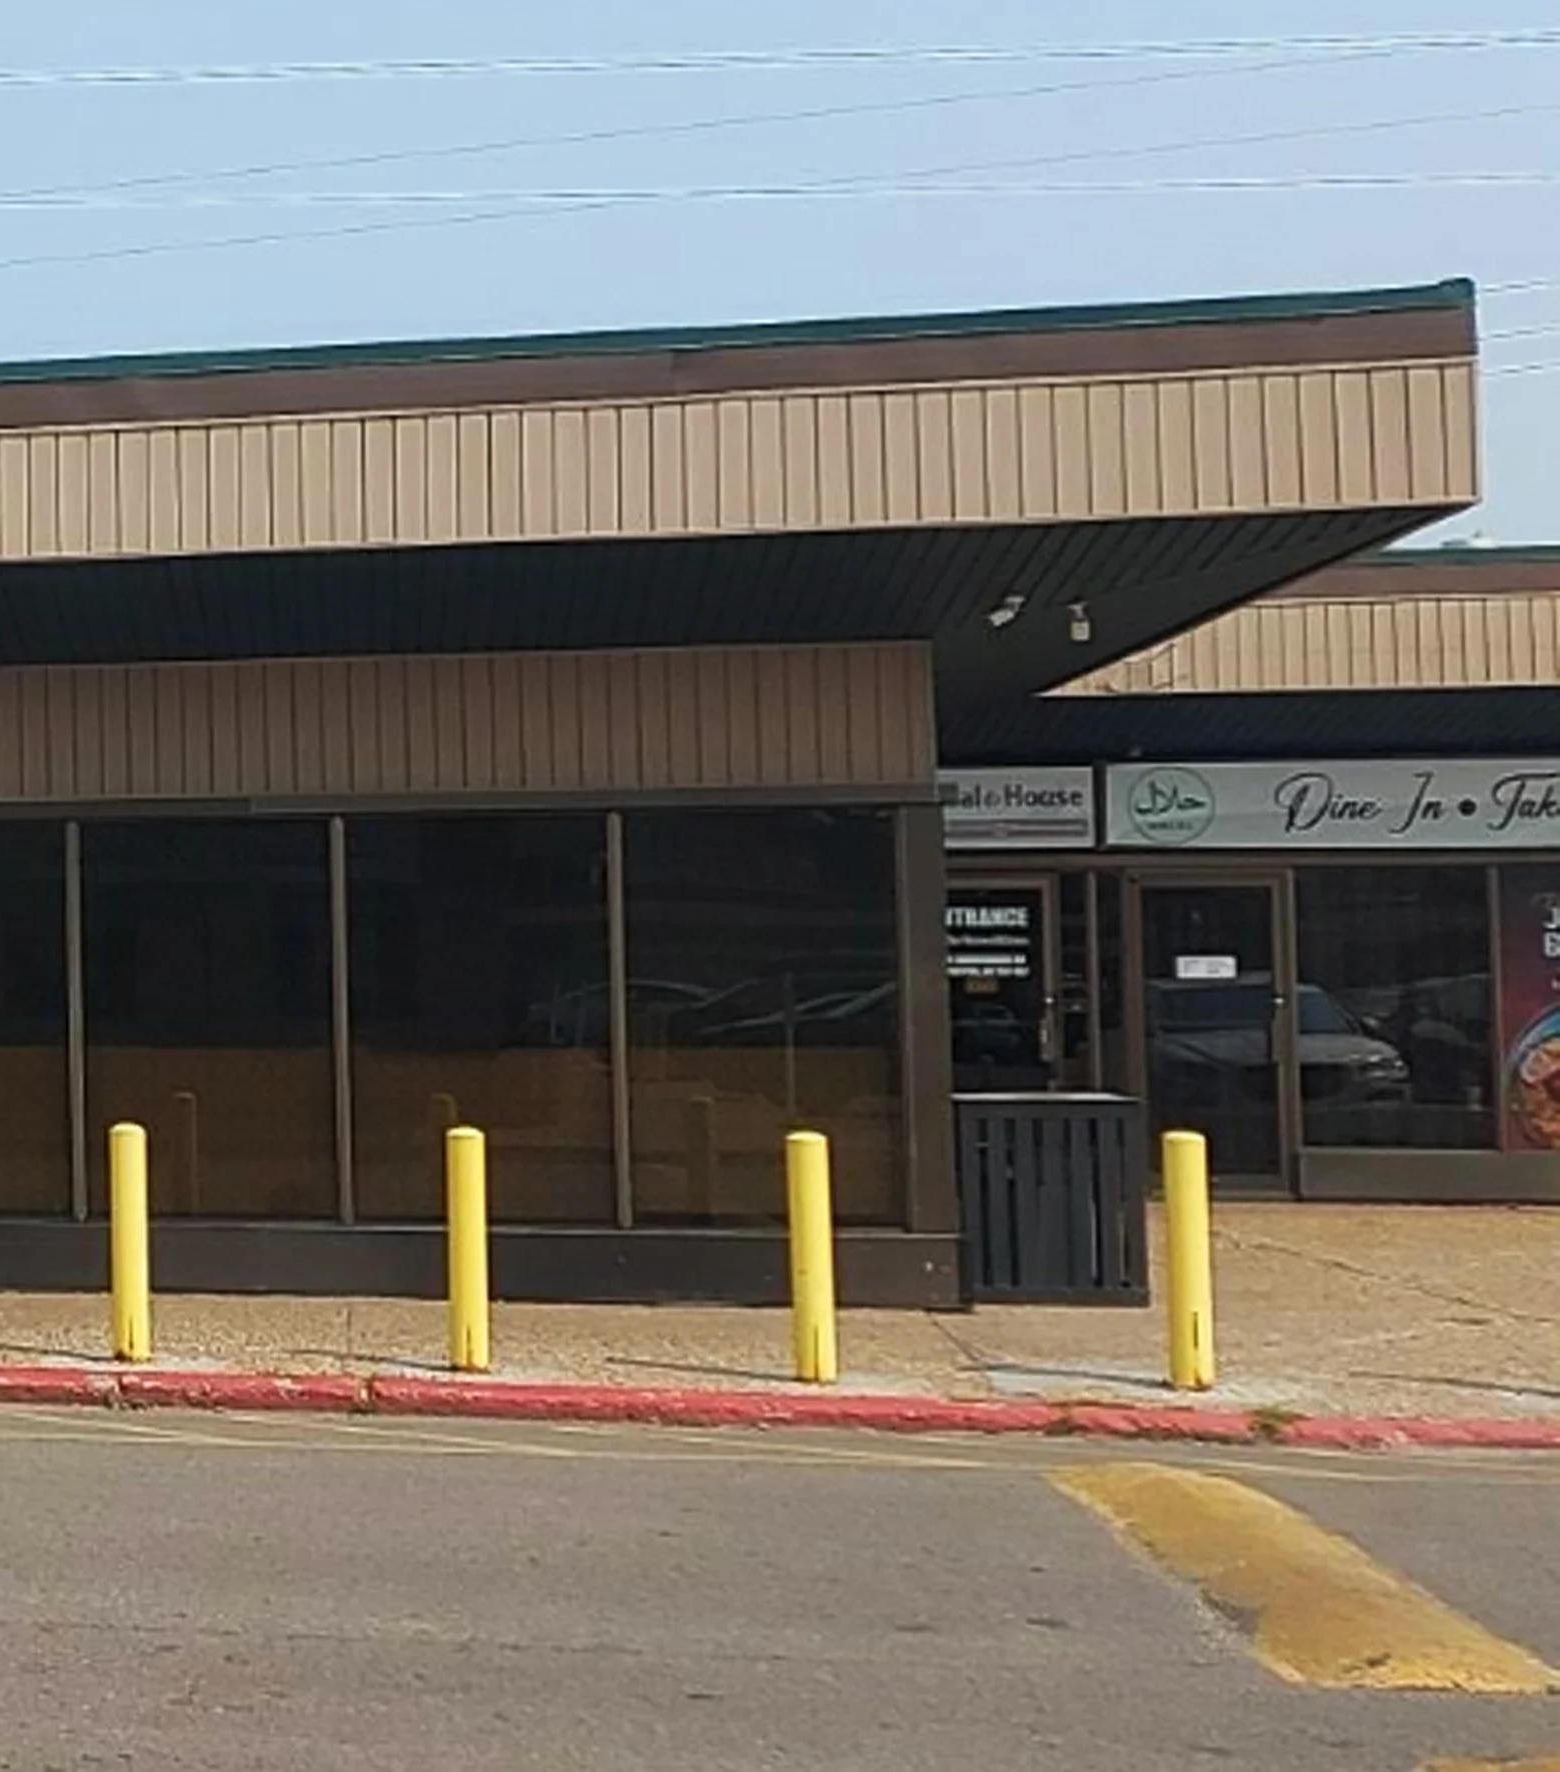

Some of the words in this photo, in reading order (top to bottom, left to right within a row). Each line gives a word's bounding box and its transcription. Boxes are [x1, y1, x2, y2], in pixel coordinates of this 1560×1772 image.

[1003, 783, 1084, 807] House
[1135, 780, 1206, 816] حلال
[1274, 772, 1383, 833] Dine
[1389, 771, 1444, 834] In
[1486, 773, 1560, 831] Tak
